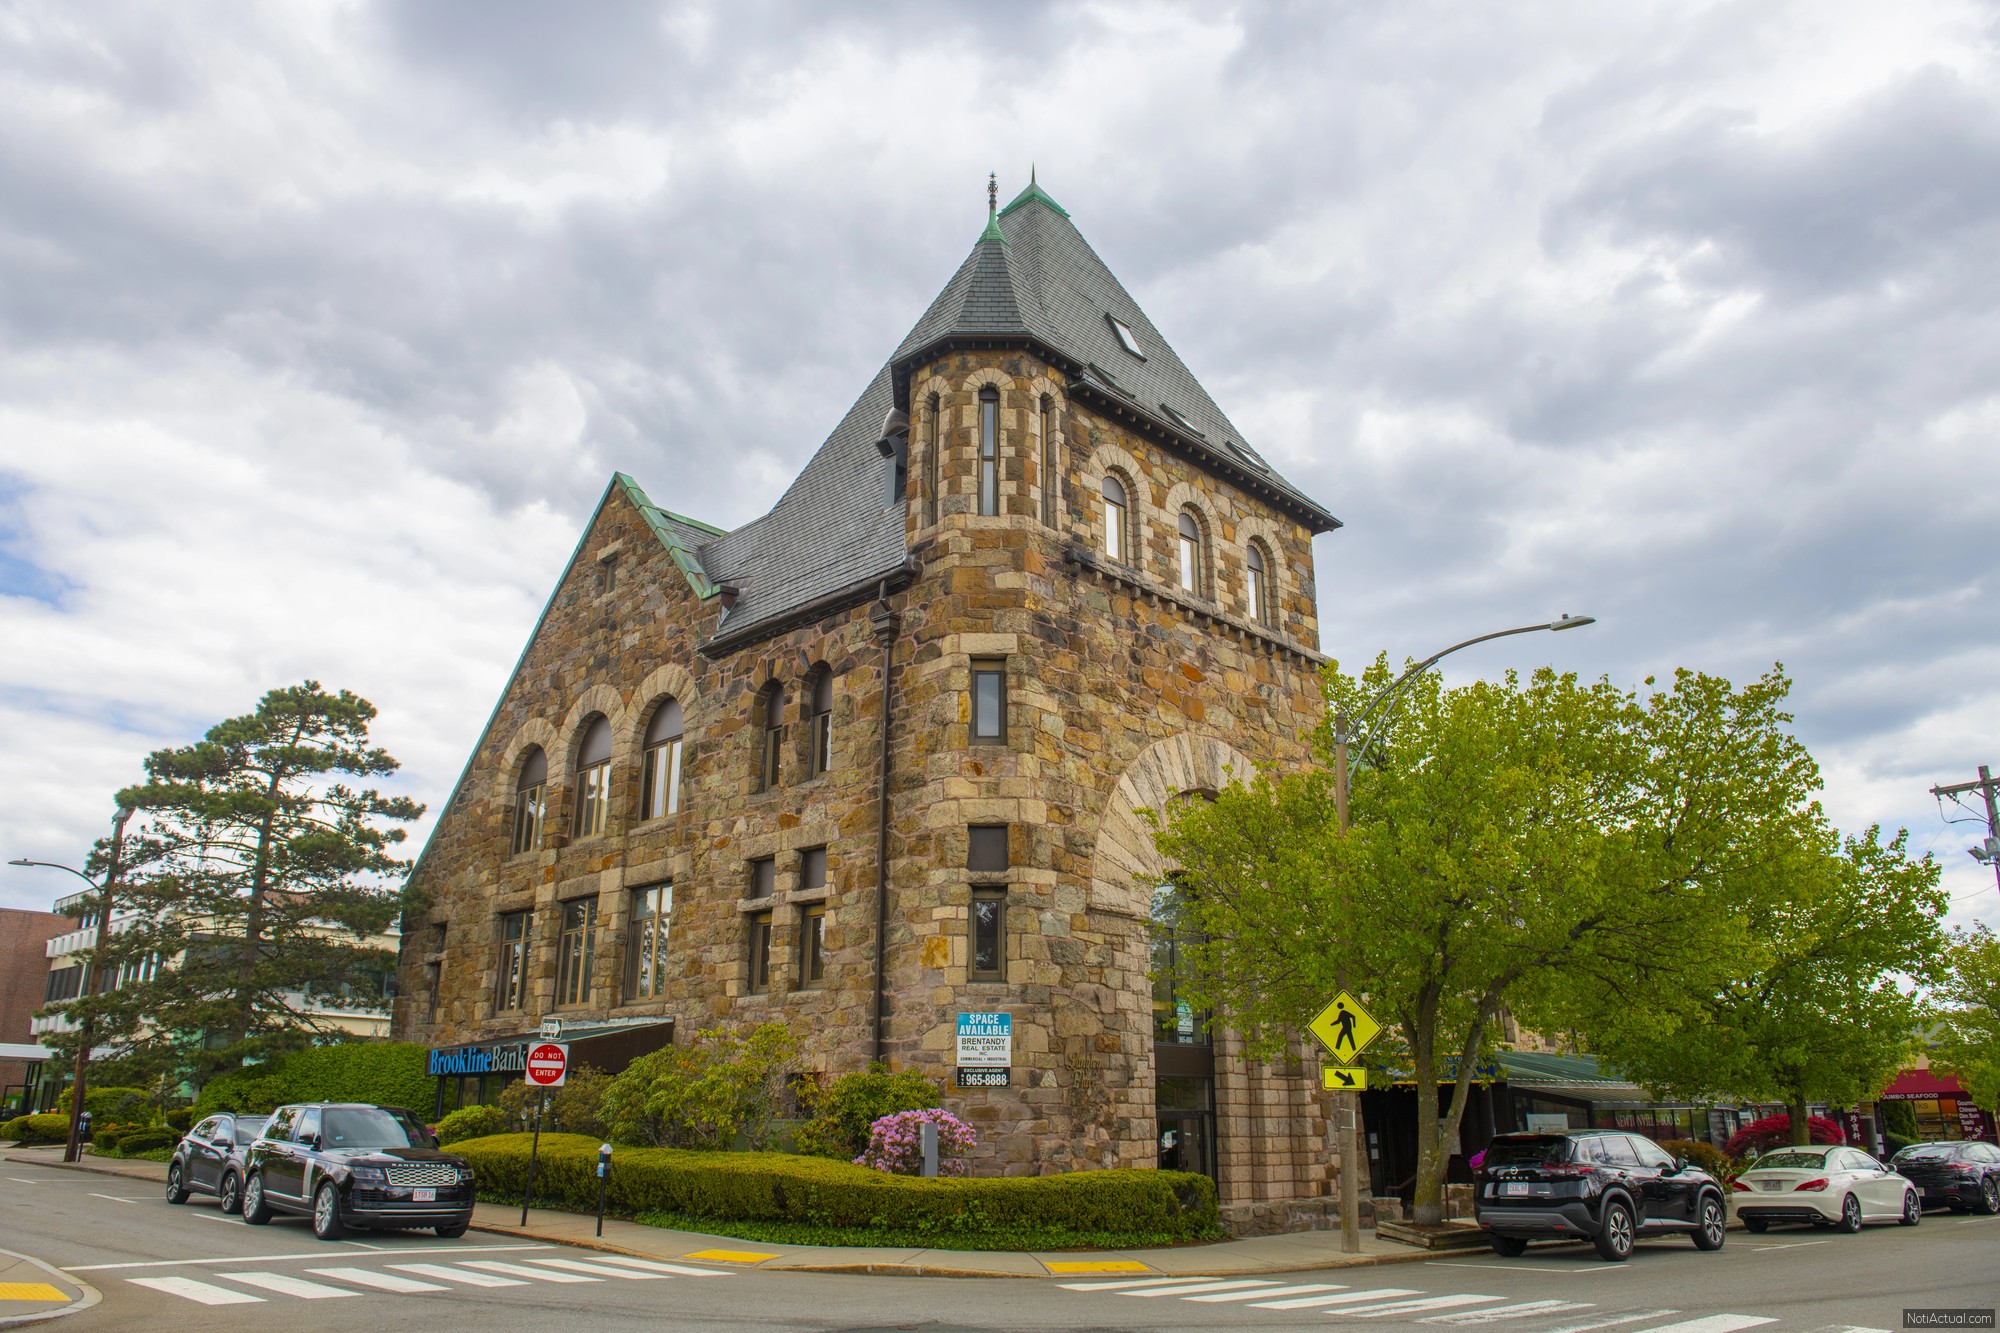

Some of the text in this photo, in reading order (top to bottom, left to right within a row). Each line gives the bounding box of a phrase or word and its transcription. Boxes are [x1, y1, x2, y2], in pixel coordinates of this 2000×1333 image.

[969, 1014, 999, 1025] SPACE
[959, 1025, 1009, 1035] AVAILABLE
[430, 1043, 528, 1074] BrooklineBank
[535, 1069, 556, 1077] ENTER
[966, 1073, 1007, 1086] 965-8888
